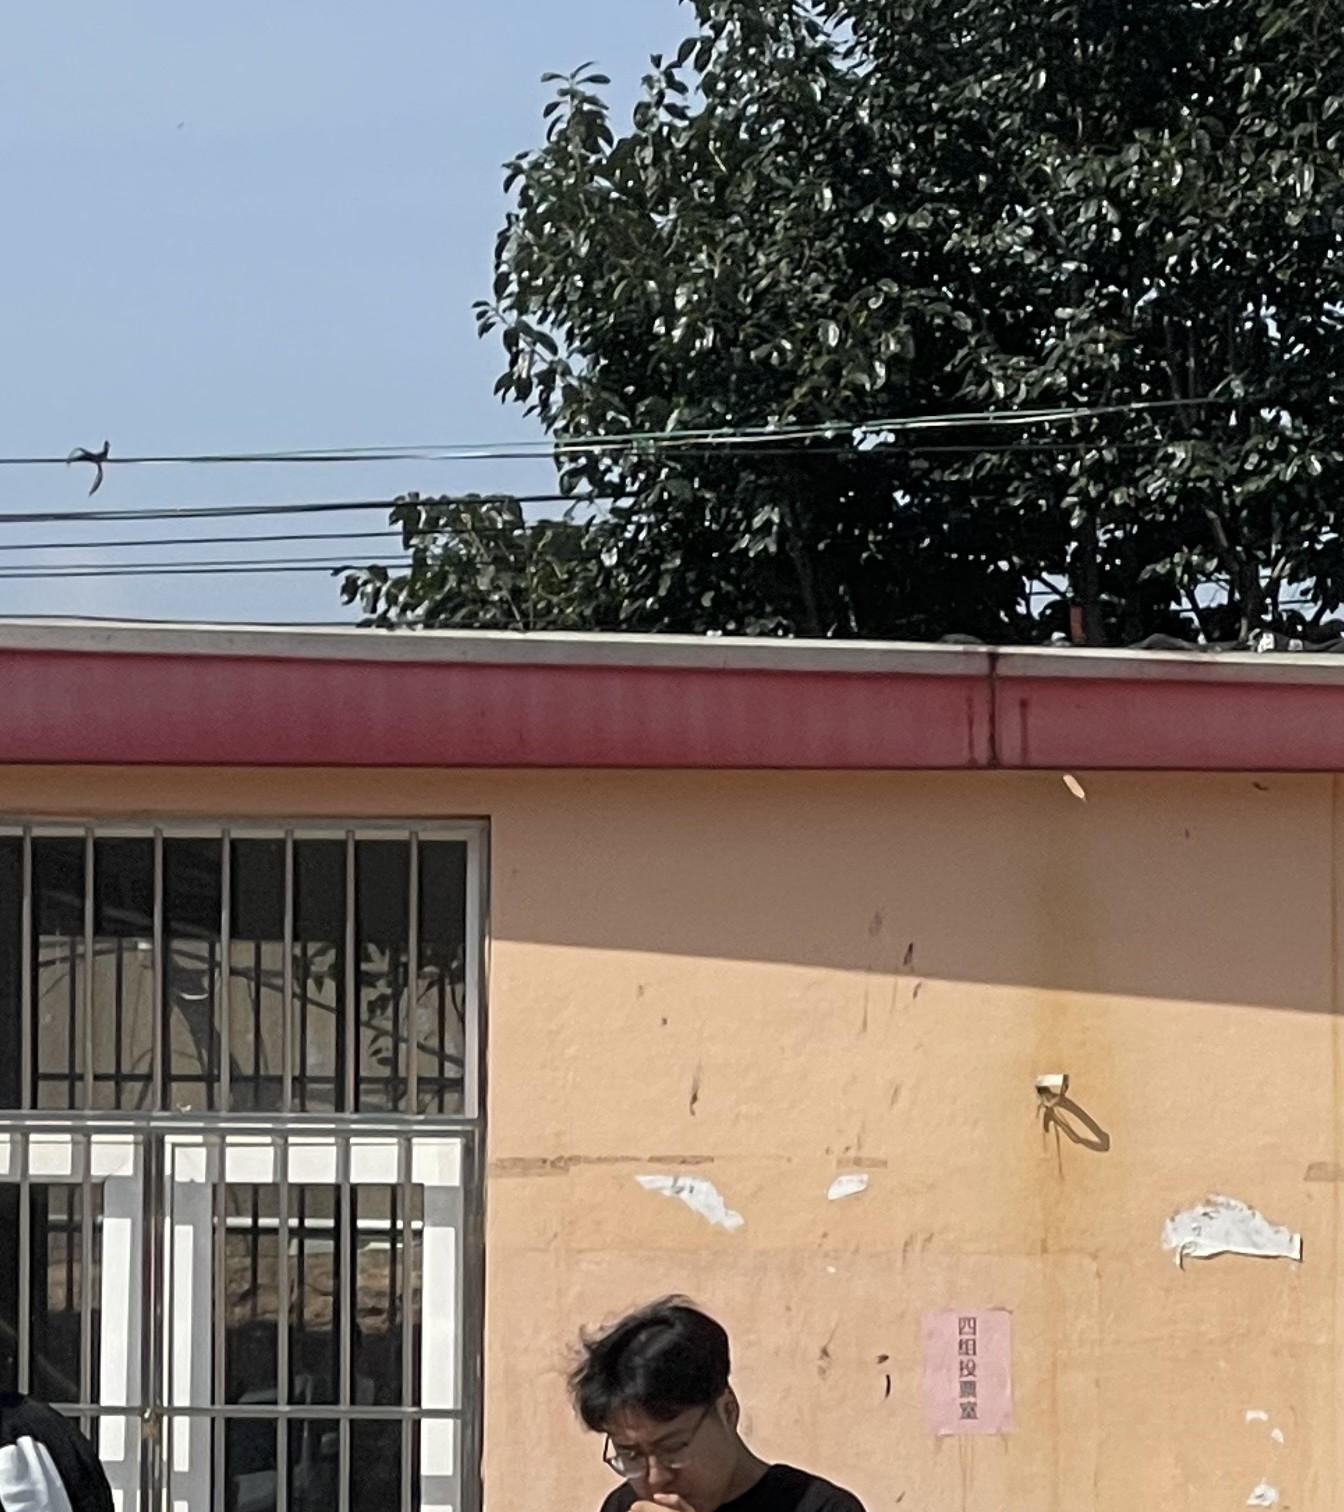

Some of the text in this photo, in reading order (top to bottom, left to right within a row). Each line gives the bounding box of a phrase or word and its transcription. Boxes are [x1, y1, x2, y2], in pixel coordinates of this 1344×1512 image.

[958, 1316, 978, 1420] 四组投票室
